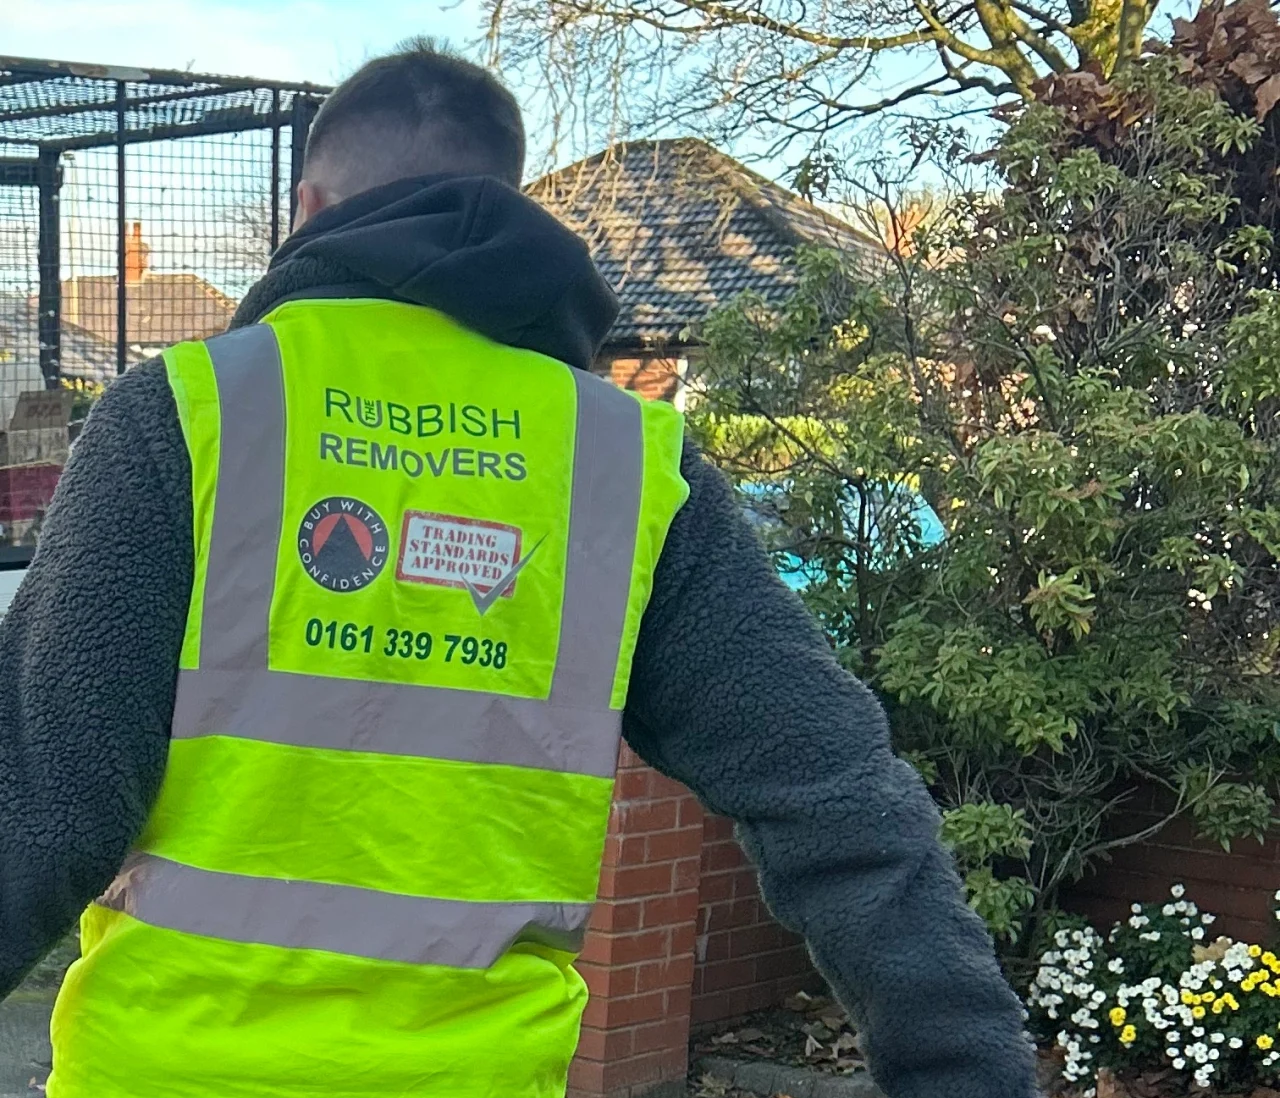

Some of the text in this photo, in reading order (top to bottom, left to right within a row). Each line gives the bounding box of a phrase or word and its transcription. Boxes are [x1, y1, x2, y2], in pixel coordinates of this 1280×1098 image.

[324, 387, 521, 440] RUBBISH
[363, 398, 375, 422] THE
[320, 432, 528, 481] REMOVERS
[303, 499, 383, 535] BUY WITH
[409, 539, 510, 567] STANDARDS
[422, 525, 497, 549] TRADING
[299, 538, 386, 590] CONFIDENCE
[411, 555, 503, 580] APPROVED
[305, 617, 508, 670] 0161 339 7938
